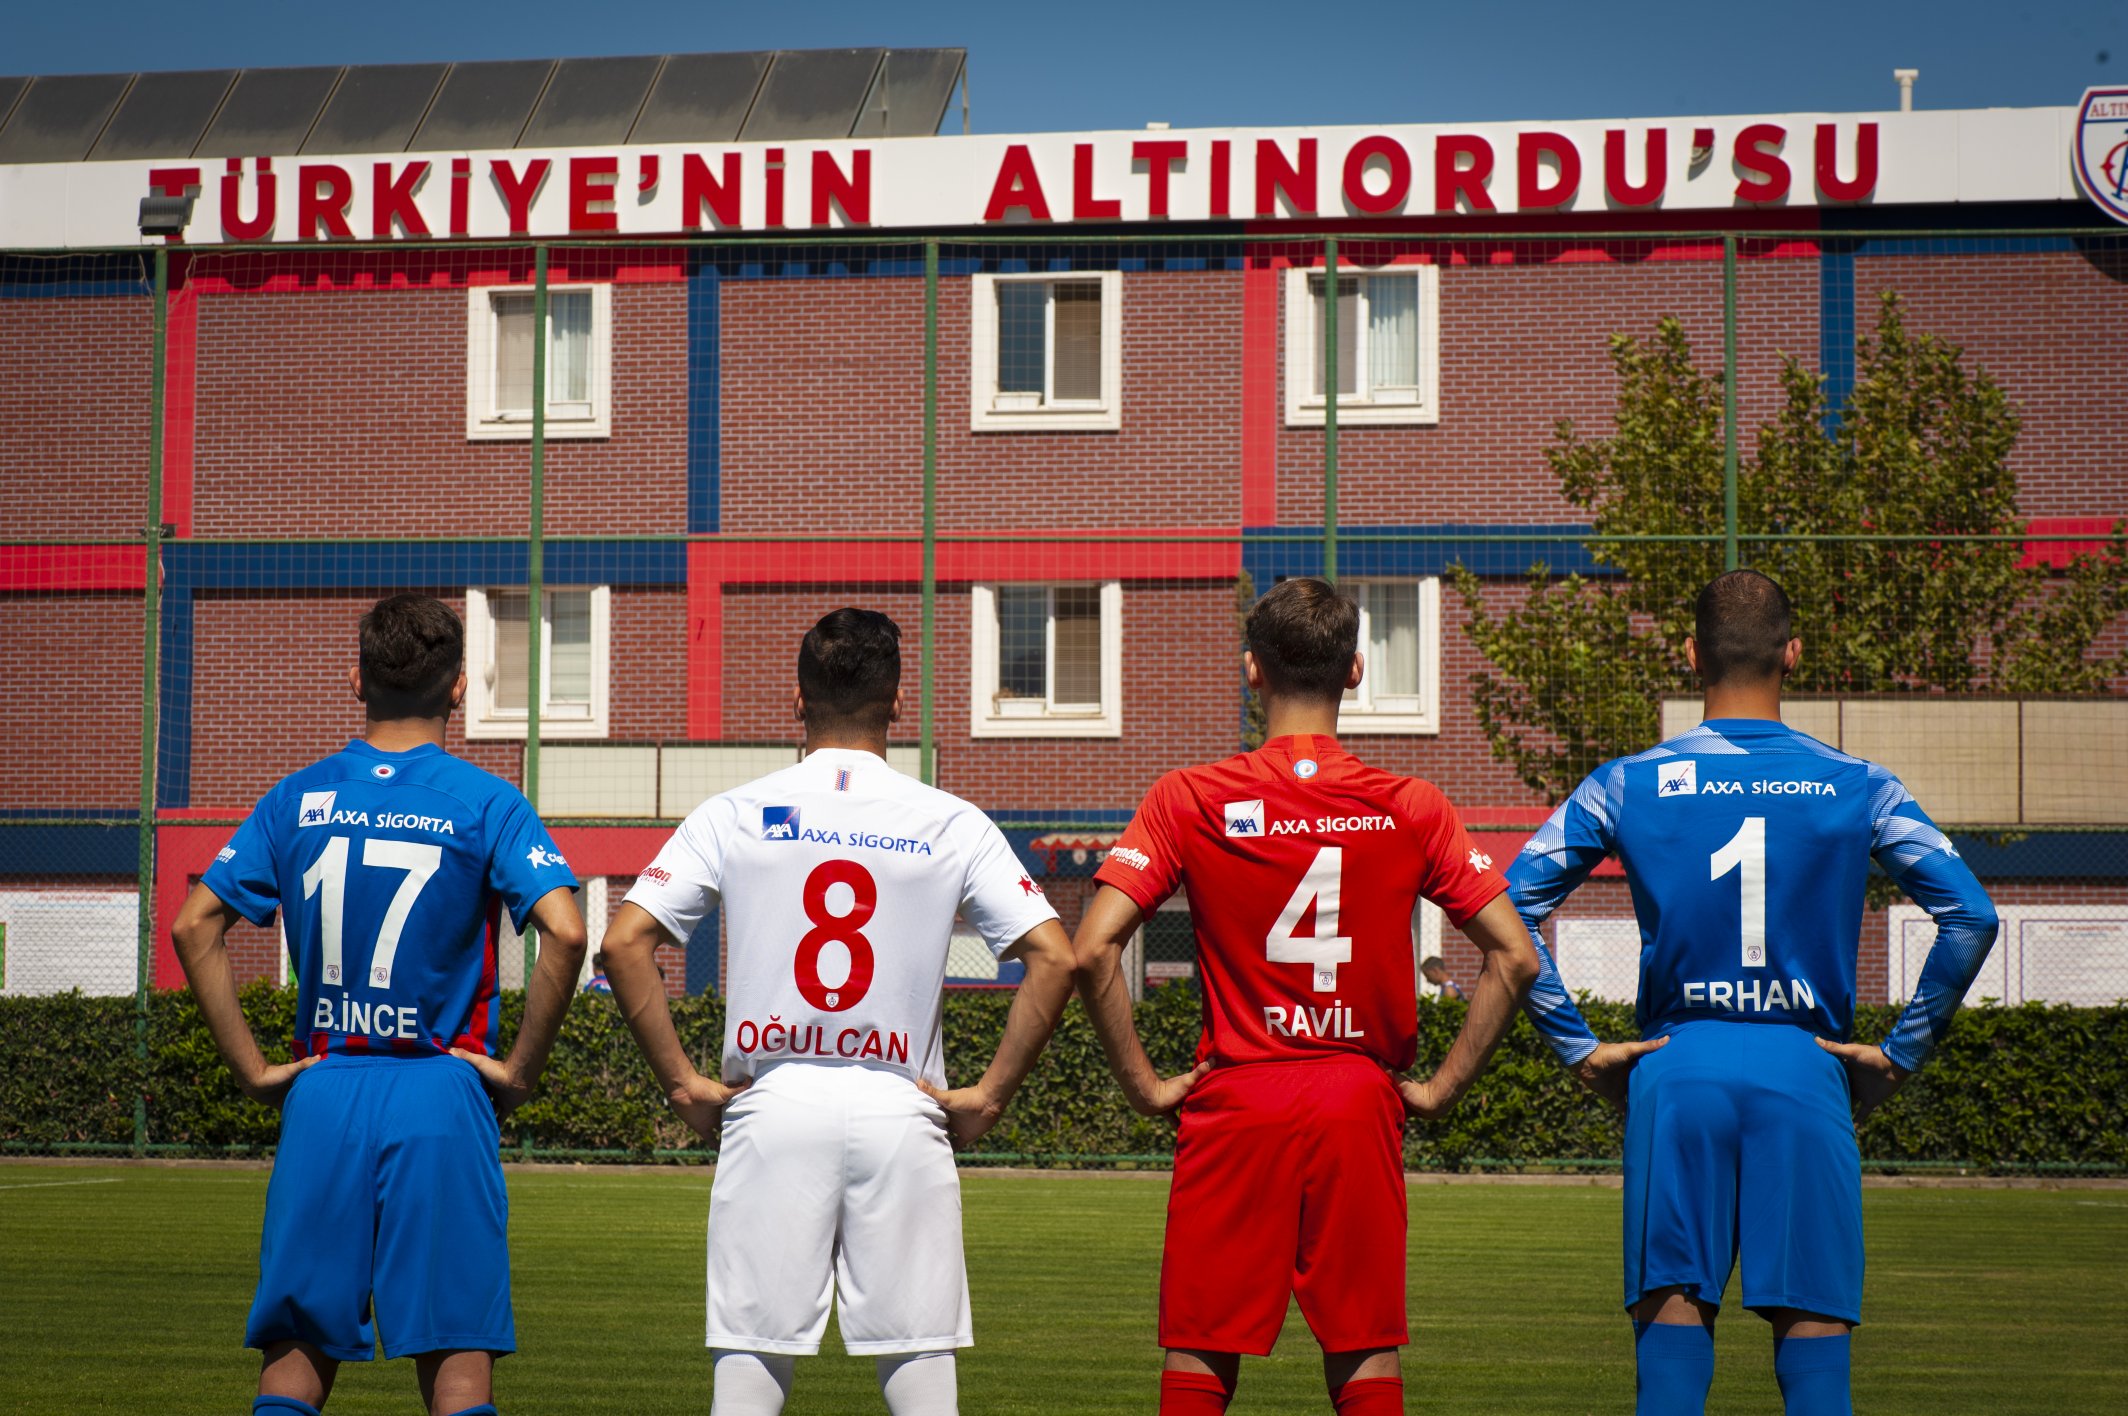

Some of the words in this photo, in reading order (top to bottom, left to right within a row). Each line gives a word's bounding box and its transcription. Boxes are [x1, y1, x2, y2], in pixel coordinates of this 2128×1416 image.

[983, 123, 1878, 219] ALTINORDU'SU
[1660, 778, 1688, 793] AXA
[1701, 781, 1744, 794] AXA
[1751, 779, 1836, 796] SİGORTA
[300, 808, 325, 823] AXA
[331, 810, 369, 826] AXA
[375, 812, 454, 834] SİGORTA
[762, 823, 794, 838] AXA
[1227, 818, 1258, 833] AXA
[1269, 819, 1310, 835] AXA
[1316, 816, 1396, 833] SİGORTA
[801, 828, 841, 845] AXA
[848, 831, 931, 855] SİGORTA
[1711, 817, 1765, 967] 1
[303, 836, 442, 989] 17
[1266, 847, 1352, 992] 4
[794, 859, 877, 1012] 8
[1684, 979, 1815, 1012] ERHAN
[314, 992, 418, 1038] B.İNCE
[1264, 1000, 1364, 1038] RAVİL
[737, 1015, 908, 1064] OĞULCAN
